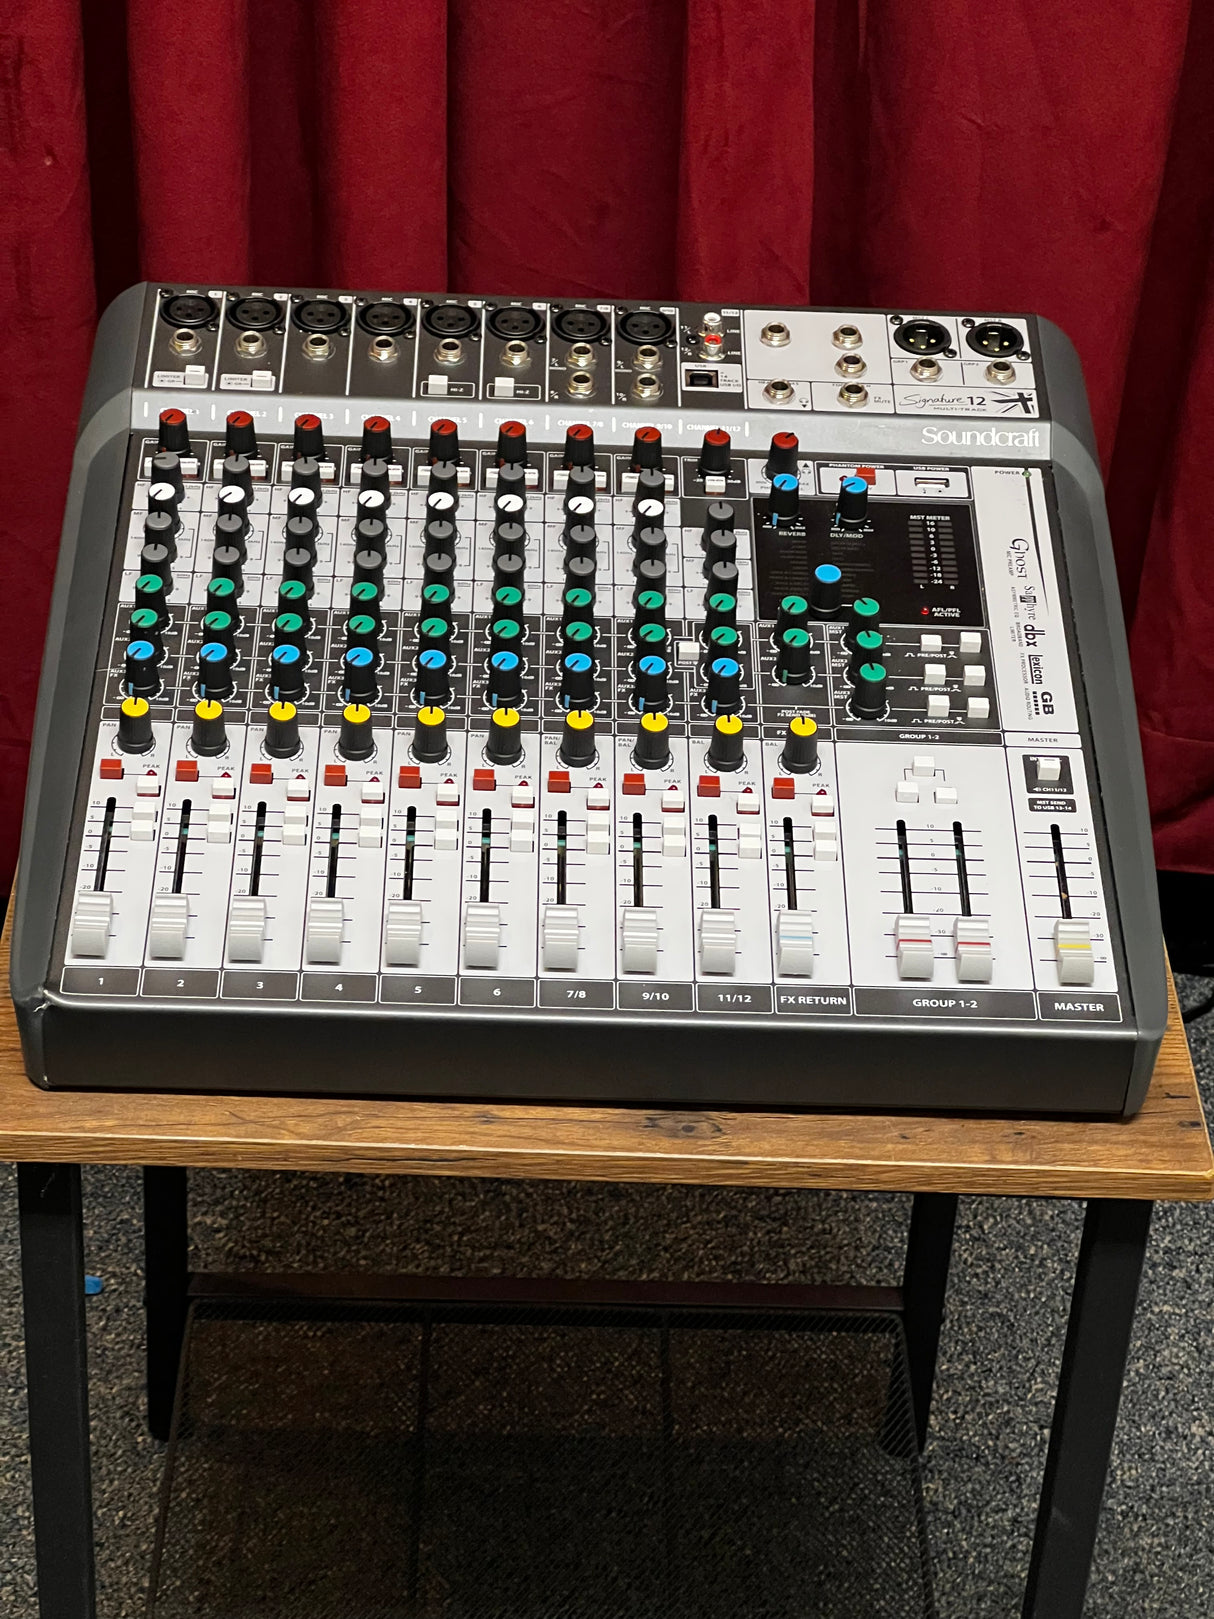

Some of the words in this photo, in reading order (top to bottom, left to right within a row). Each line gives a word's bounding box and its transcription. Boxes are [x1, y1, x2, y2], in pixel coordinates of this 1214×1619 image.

[899, 393, 965, 408] Signature
[967, 396, 986, 405] 12
[922, 427, 1040, 447] Soundcraft
[1024, 624, 1046, 647] dbx
[1028, 655, 1043, 684] lexicon
[1041, 691, 1054, 715] GB
[567, 990, 586, 999] 7/8
[643, 992, 669, 1001] 9/10
[718, 994, 752, 1003] 11/12
[780, 996, 796, 1004] FX
[798, 997, 847, 1005] RETURN
[913, 999, 957, 1008] GROUP
[959, 999, 978, 1008] 1-2
[1054, 1003, 1104, 1012] MASTER
